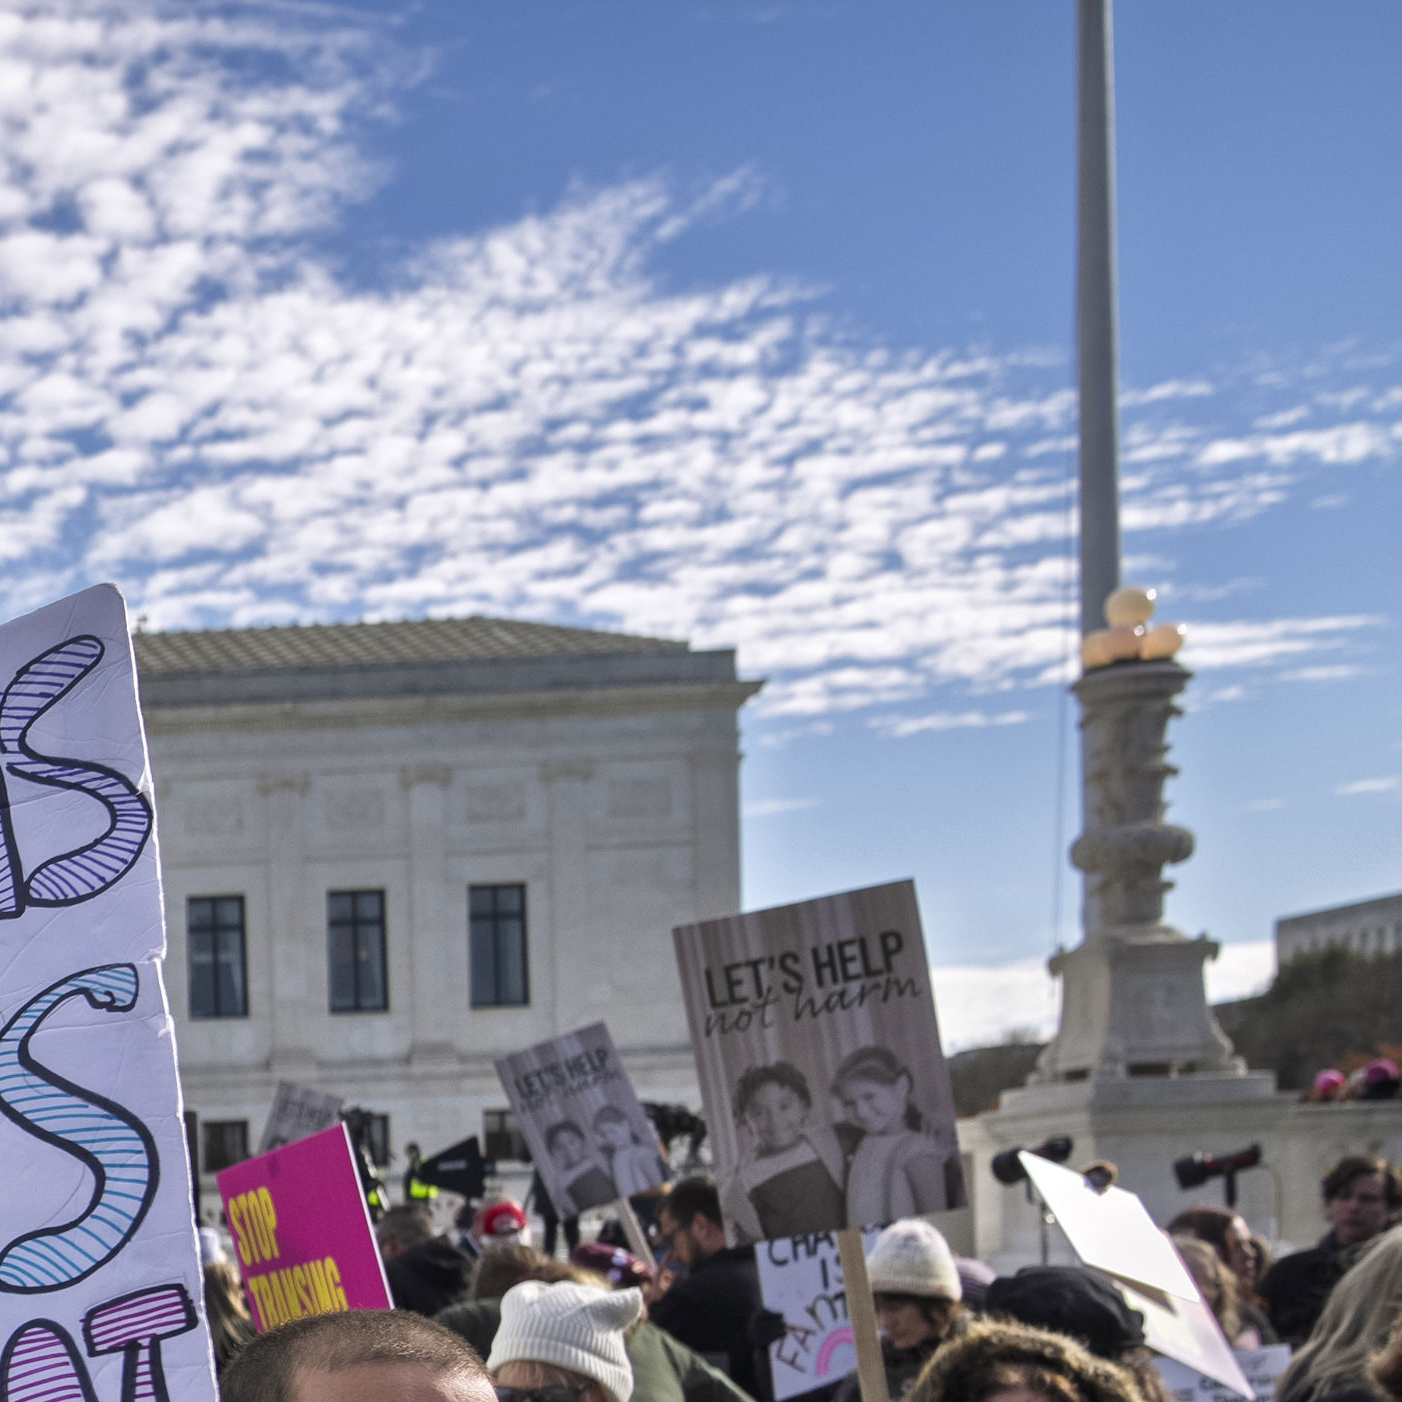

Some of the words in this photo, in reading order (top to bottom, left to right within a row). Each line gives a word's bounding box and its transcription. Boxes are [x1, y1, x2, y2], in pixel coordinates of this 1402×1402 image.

[704, 951, 805, 1010] LET'S
[811, 930, 904, 988] HELP
[228, 1186, 280, 1267] STOP
